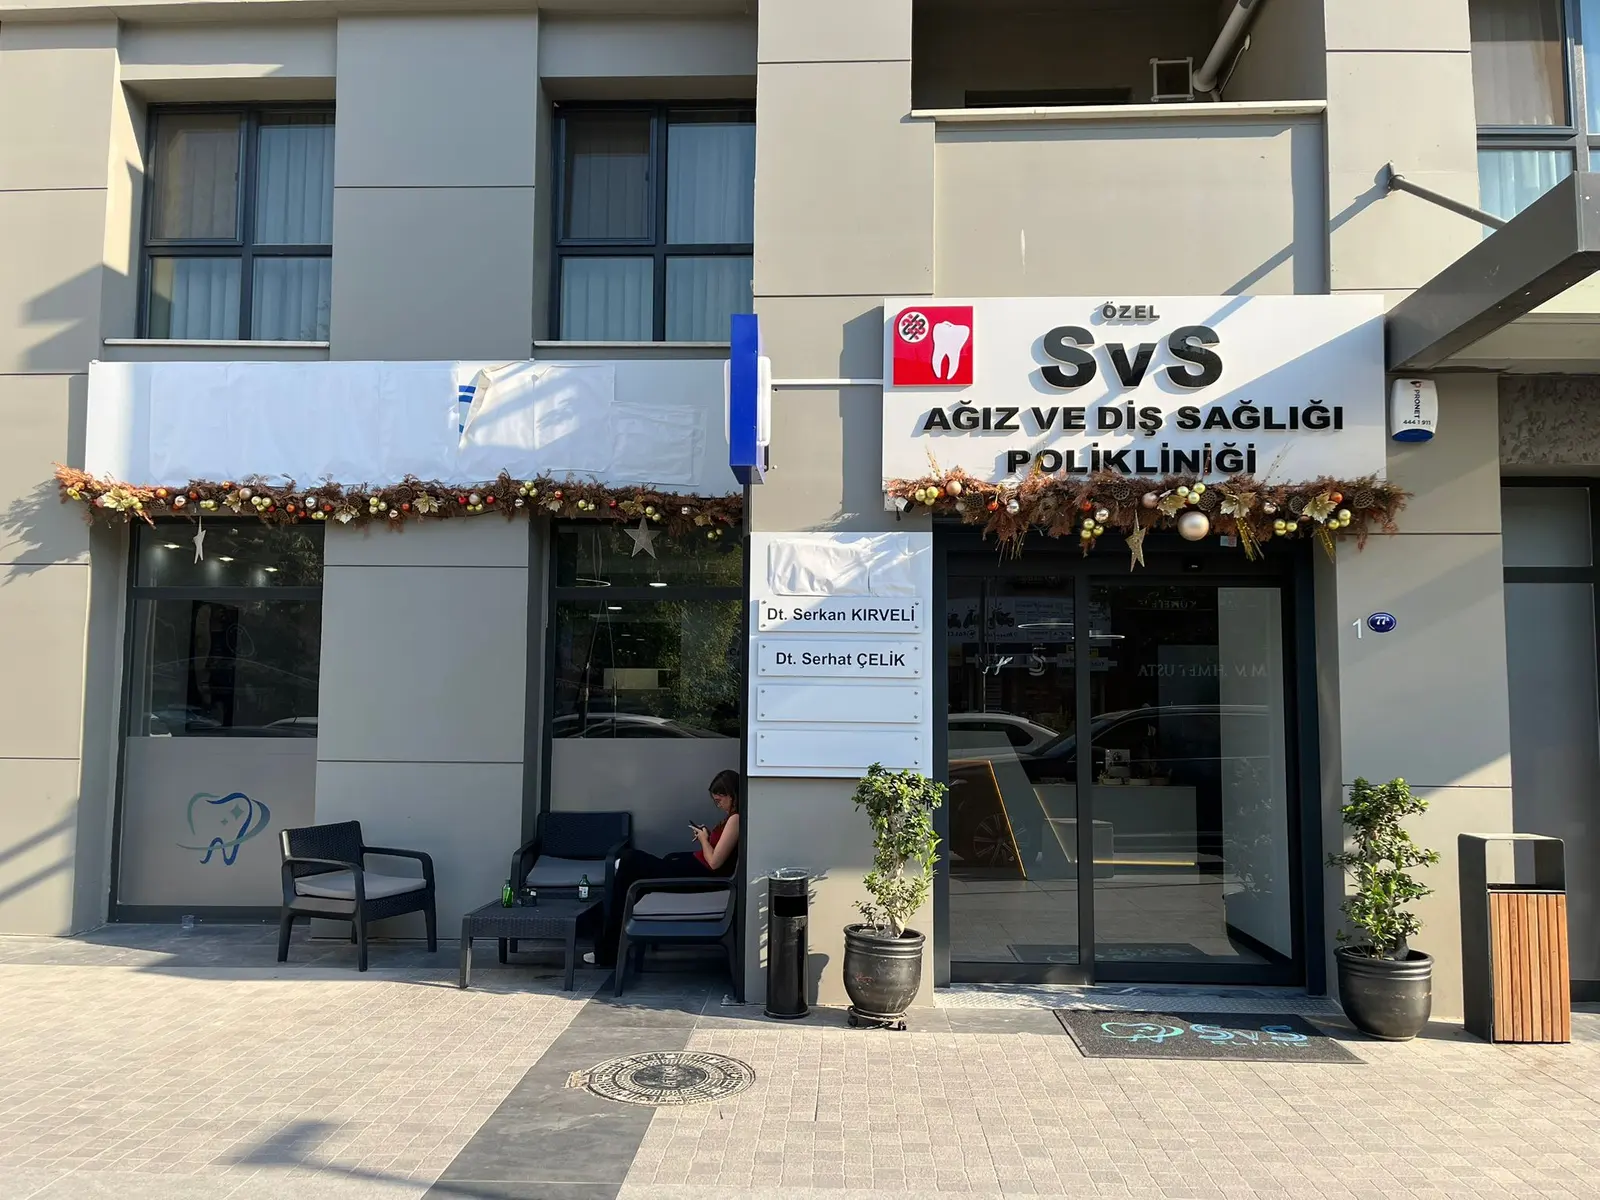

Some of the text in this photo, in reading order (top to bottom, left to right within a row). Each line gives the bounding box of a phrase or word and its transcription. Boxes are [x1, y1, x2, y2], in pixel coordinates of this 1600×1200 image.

[1102, 301, 1160, 319] ÖZEL
[1041, 325, 1223, 388] SvS
[923, 399, 1343, 436] AĞIZ VE DİŞ SAĞLIĞI
[1007, 443, 1256, 474] POLİKLİNİĞİ
[767, 606, 915, 621] Dt. Serkan KIRVELİ
[1352, 618, 1362, 639] 1
[776, 651, 906, 668] Dt. Serhat ÇELİK
